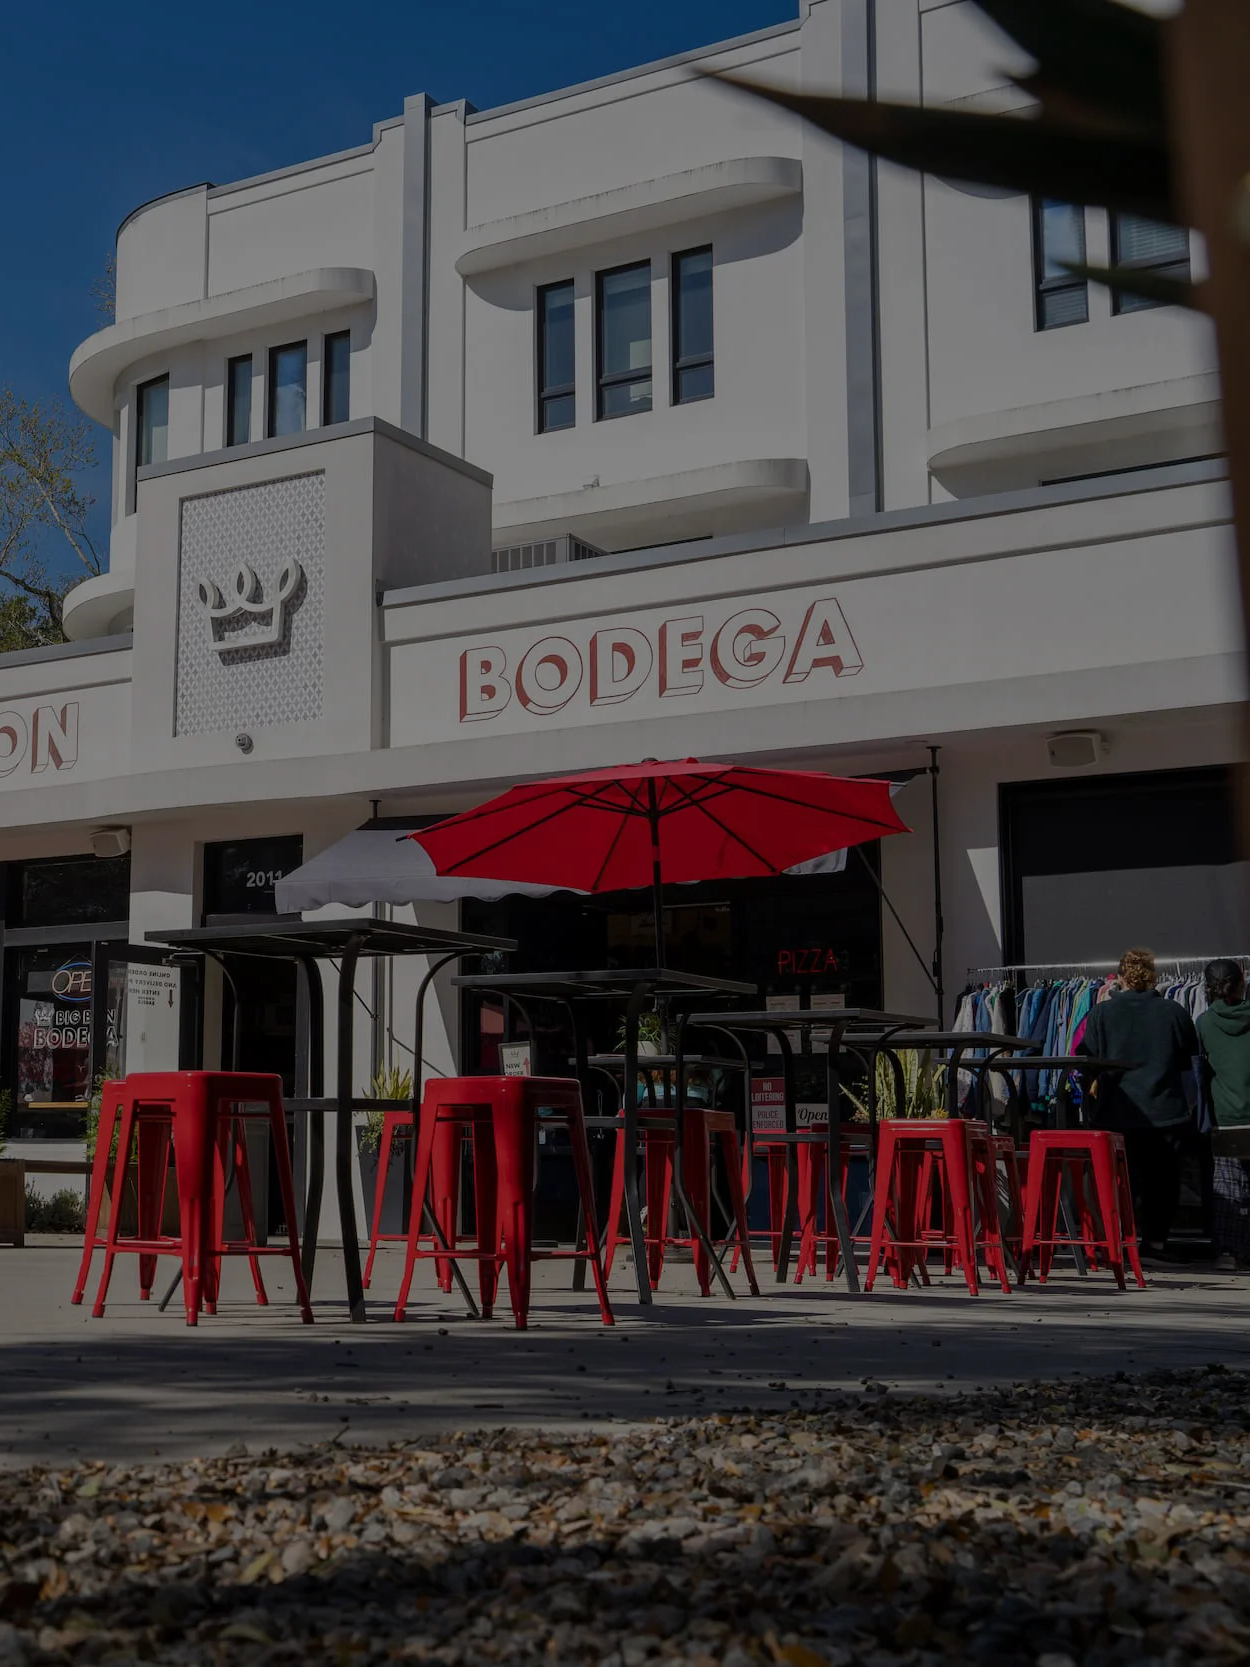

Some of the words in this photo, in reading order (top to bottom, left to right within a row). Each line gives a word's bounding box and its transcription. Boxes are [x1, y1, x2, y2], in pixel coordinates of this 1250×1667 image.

[459, 597, 865, 723] BODEGA
[776, 947, 838, 976] PIZZA
[51, 969, 93, 994] OPE
[55, 1010, 82, 1026] BIG
[33, 1026, 120, 1049] BODEA
[762, 1081, 773, 1092] NO
[751, 1092, 784, 1103] LOITERING
[757, 1110, 779, 1119] POLICE
[797, 1108, 829, 1124] Open
[752, 1120, 784, 1129] ENFORCED
